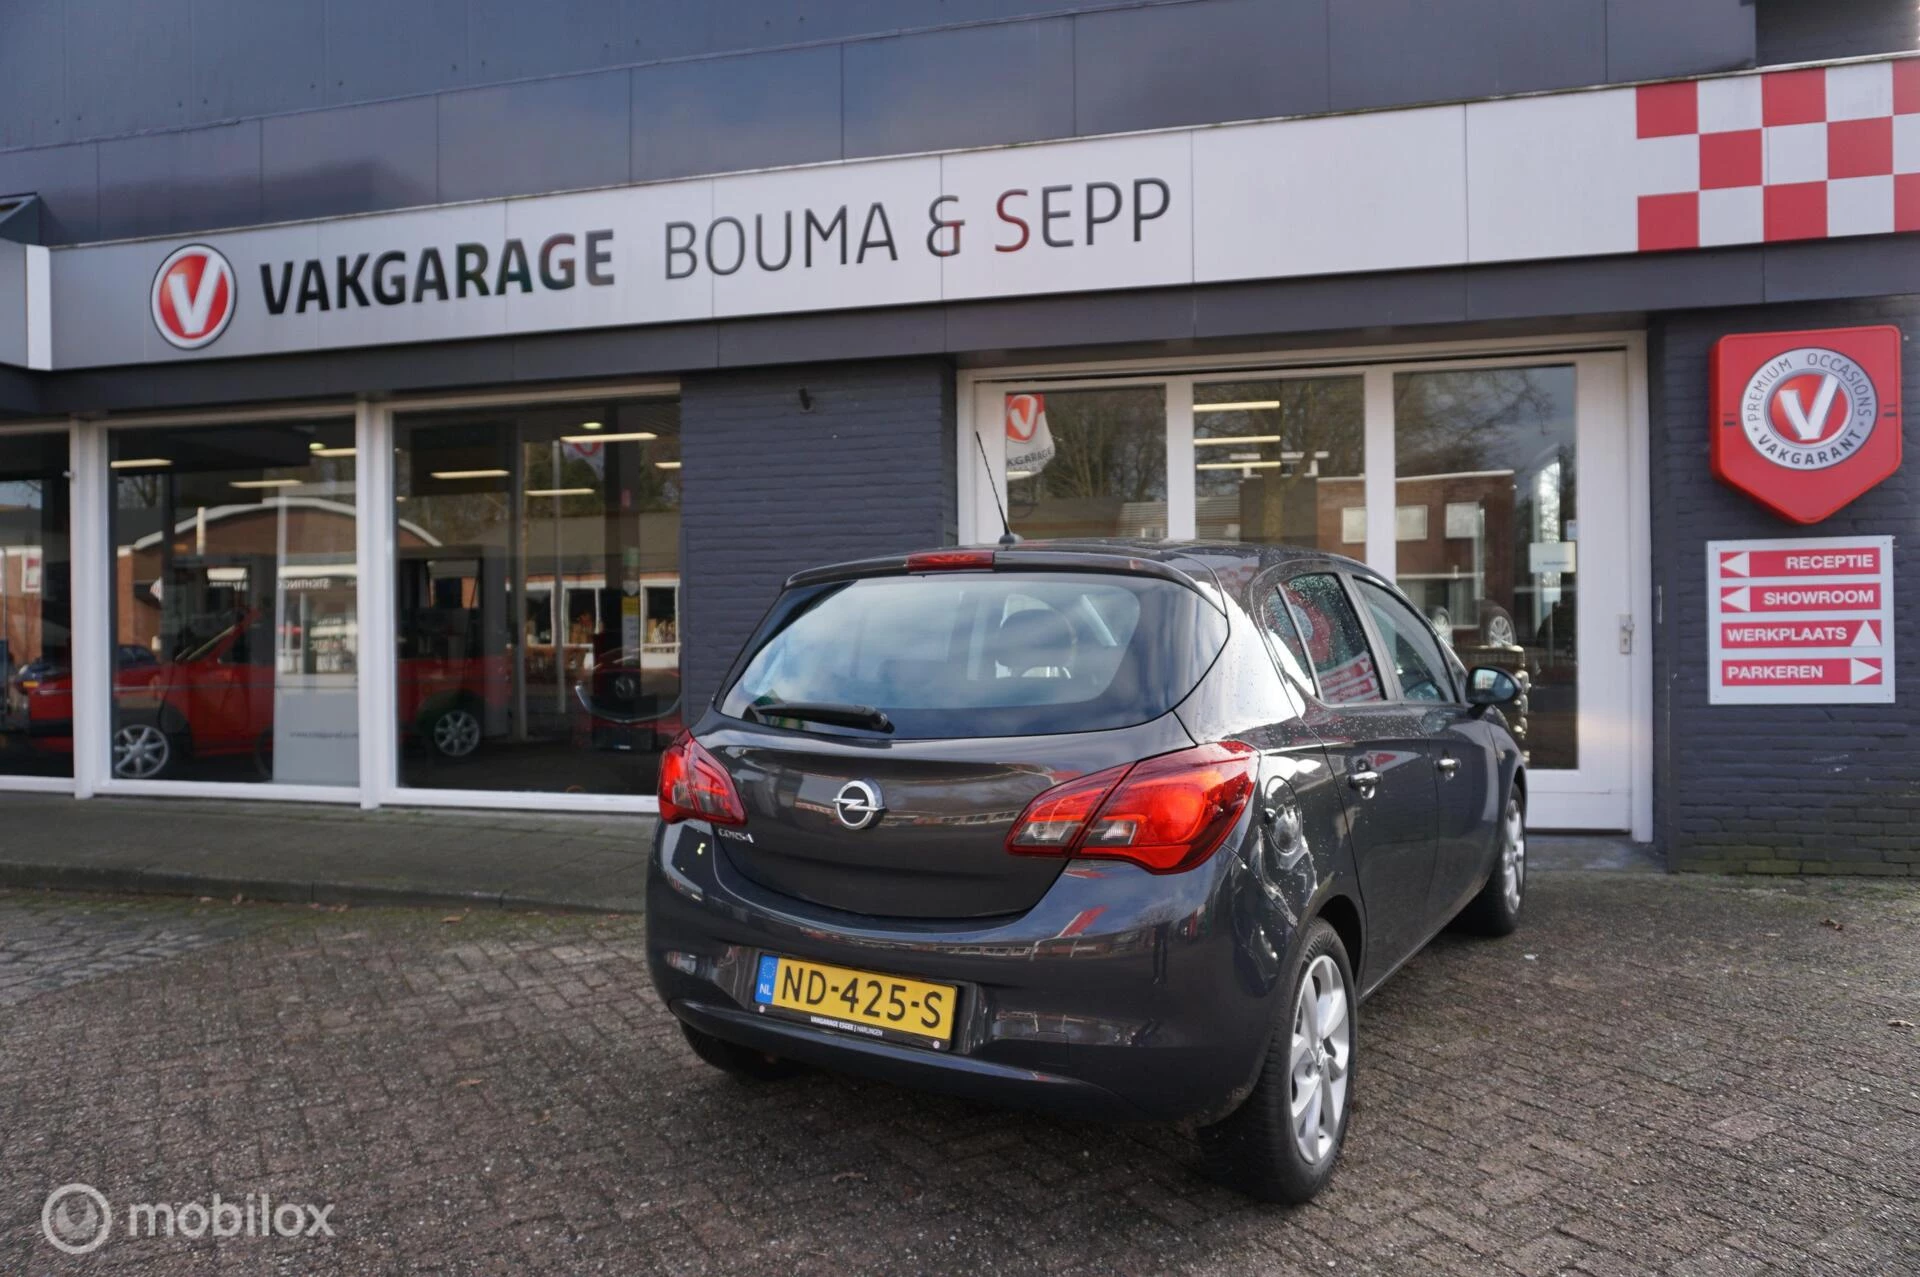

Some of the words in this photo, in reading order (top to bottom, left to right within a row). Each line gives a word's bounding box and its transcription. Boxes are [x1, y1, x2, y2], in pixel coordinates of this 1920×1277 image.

[259, 229, 615, 315] VAKGARAGE
[664, 201, 899, 281] BOUMA
[926, 194, 965, 258] &
[994, 177, 1172, 253] SEPP
[1746, 357, 1794, 422] PREMIUM
[1806, 352, 1873, 418] OCCASIONS
[1757, 429, 1863, 465] VAKGARANT
[1785, 554, 1874, 570] RECEPTIE
[1763, 590, 1874, 606] SHOWROOM
[1727, 627, 1848, 642] WERKPLAATS
[1727, 665, 1824, 679] PARKEREN
[718, 828, 754, 844] CORSA
[759, 983, 772, 996] NL
[781, 965, 943, 1029] ND-425-S
